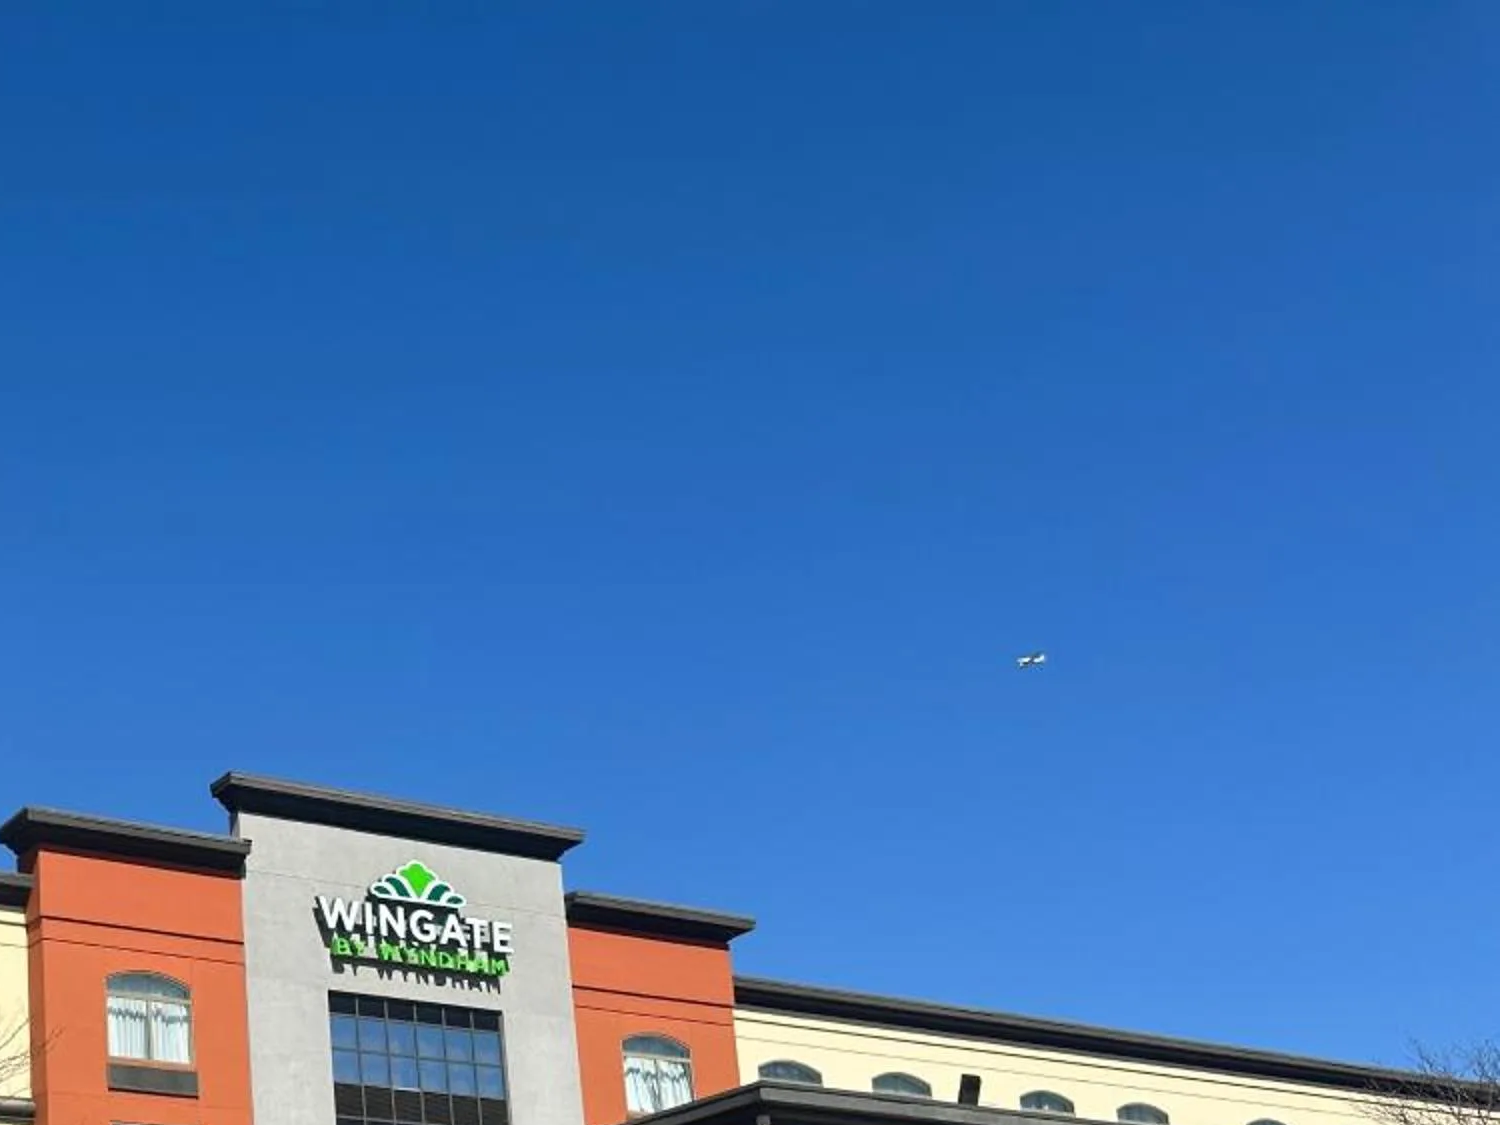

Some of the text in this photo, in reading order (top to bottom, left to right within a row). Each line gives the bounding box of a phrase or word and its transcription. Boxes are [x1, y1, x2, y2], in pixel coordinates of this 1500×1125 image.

[317, 895, 514, 954] WINGATE
[334, 935, 510, 976] BY WYNDHAM
